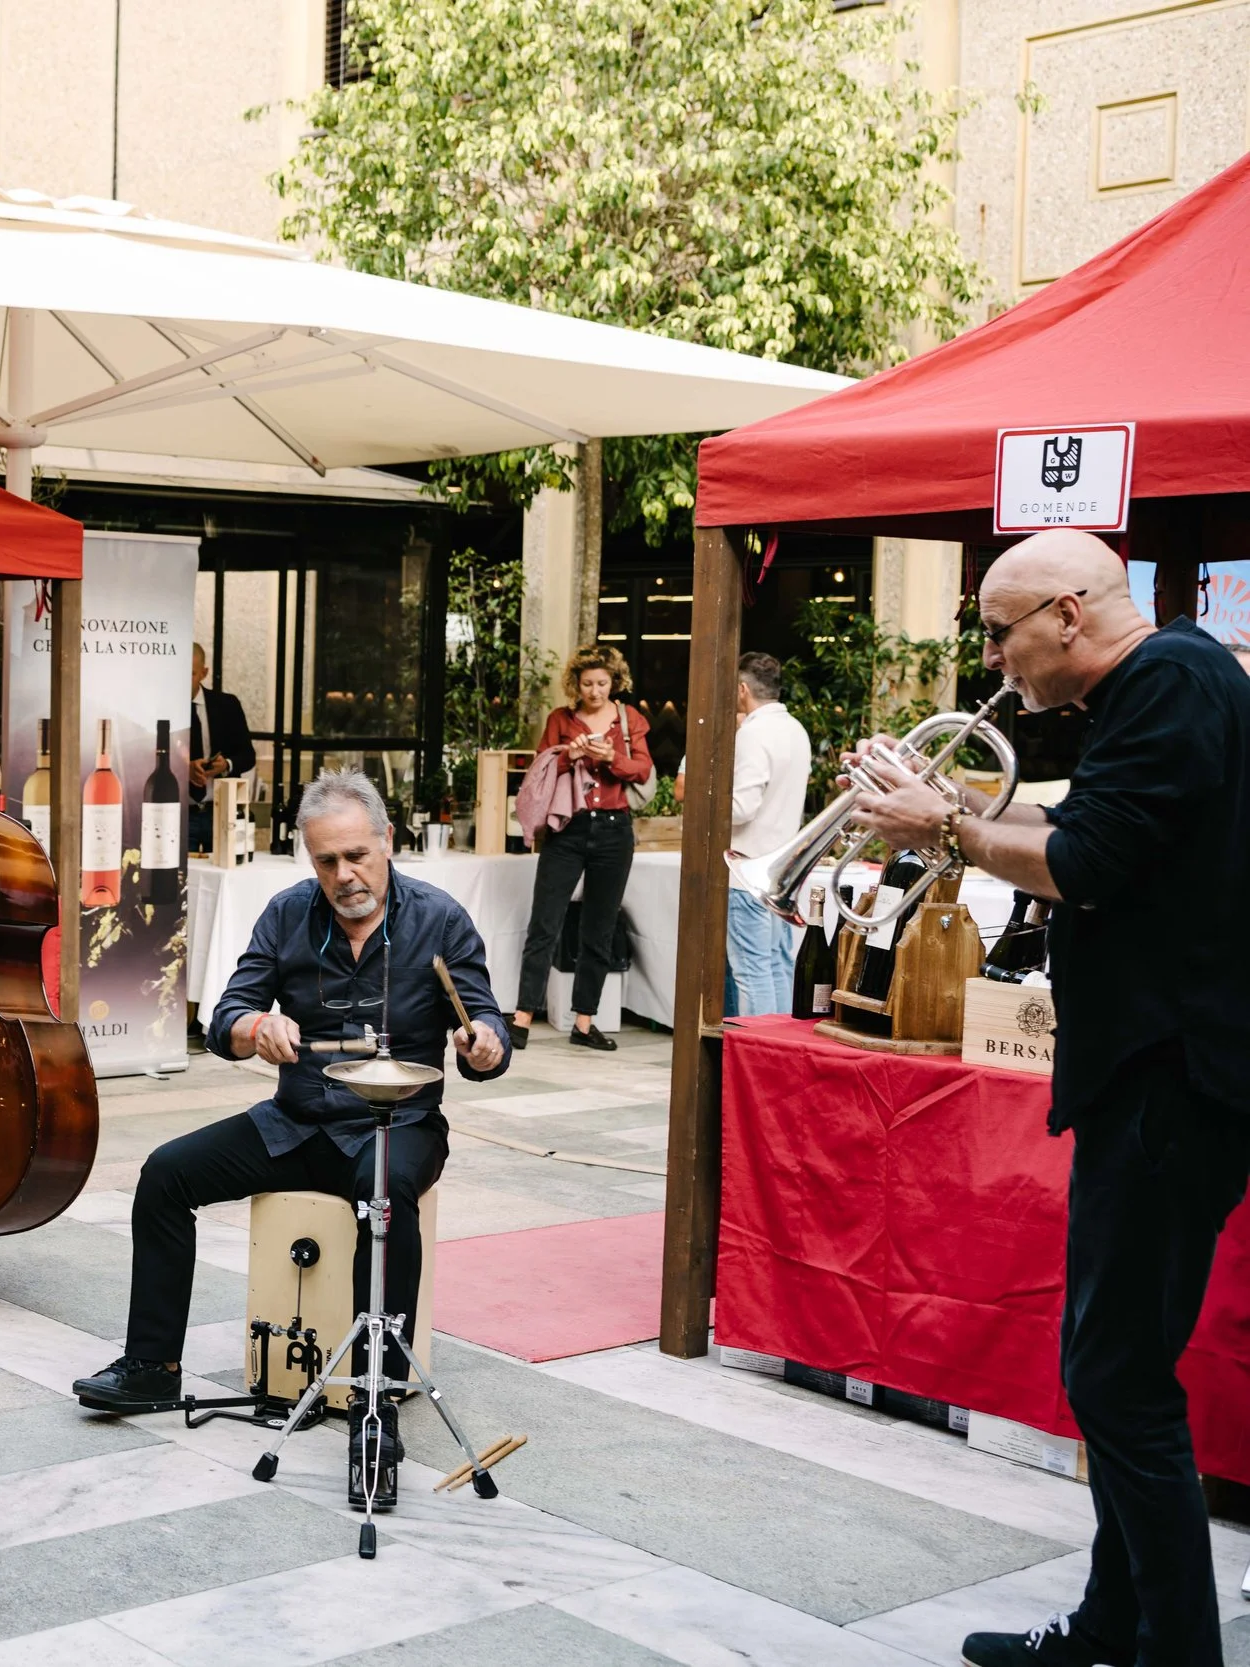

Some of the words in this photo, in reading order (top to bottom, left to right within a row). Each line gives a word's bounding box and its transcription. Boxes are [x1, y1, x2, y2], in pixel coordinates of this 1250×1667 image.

[1019, 502, 1098, 514] GOMENDE
[96, 640, 114, 654] LA
[119, 641, 177, 655] STORIA
[985, 1039, 1052, 1062] BERSA
